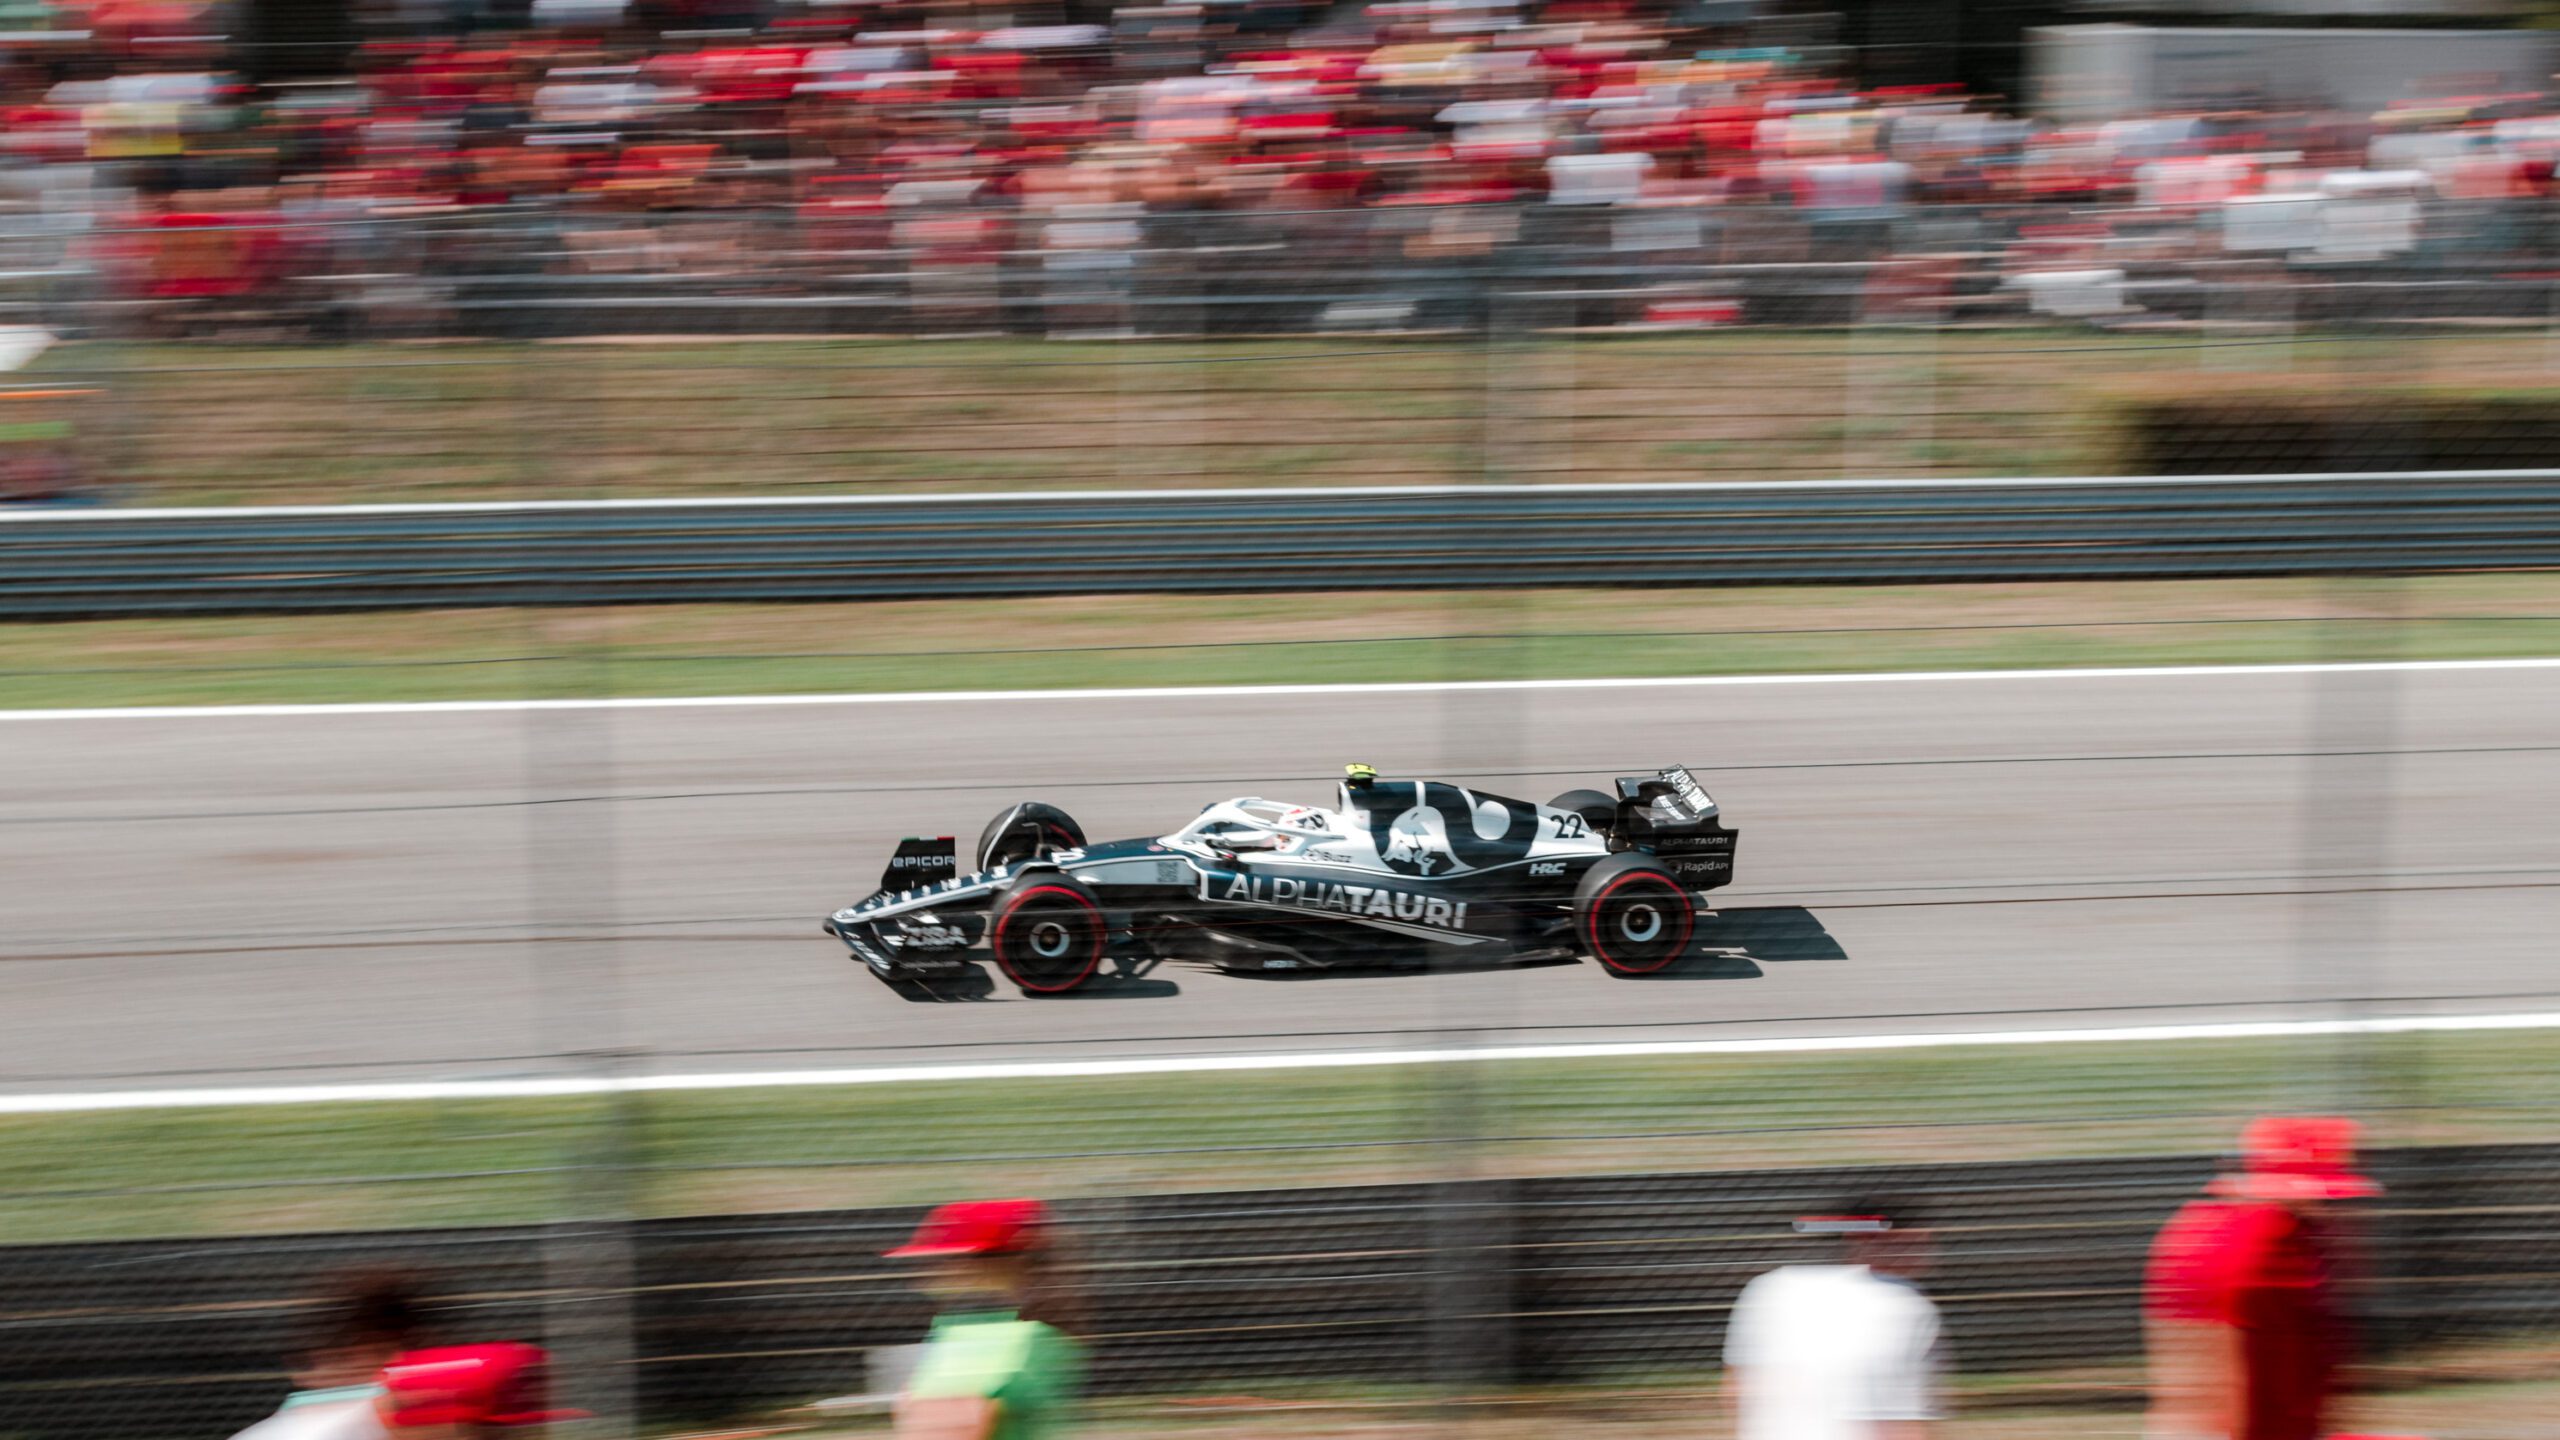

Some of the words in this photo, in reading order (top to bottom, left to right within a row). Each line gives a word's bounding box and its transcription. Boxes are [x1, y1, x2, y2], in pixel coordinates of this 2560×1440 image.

[1550, 814, 1585, 839] 22
[1660, 837, 1729, 846] ALPHATAURI
[892, 855, 956, 867] EPICOR
[1529, 862, 1567, 875] HRC
[1225, 873, 1468, 929] ALPHATAURI
